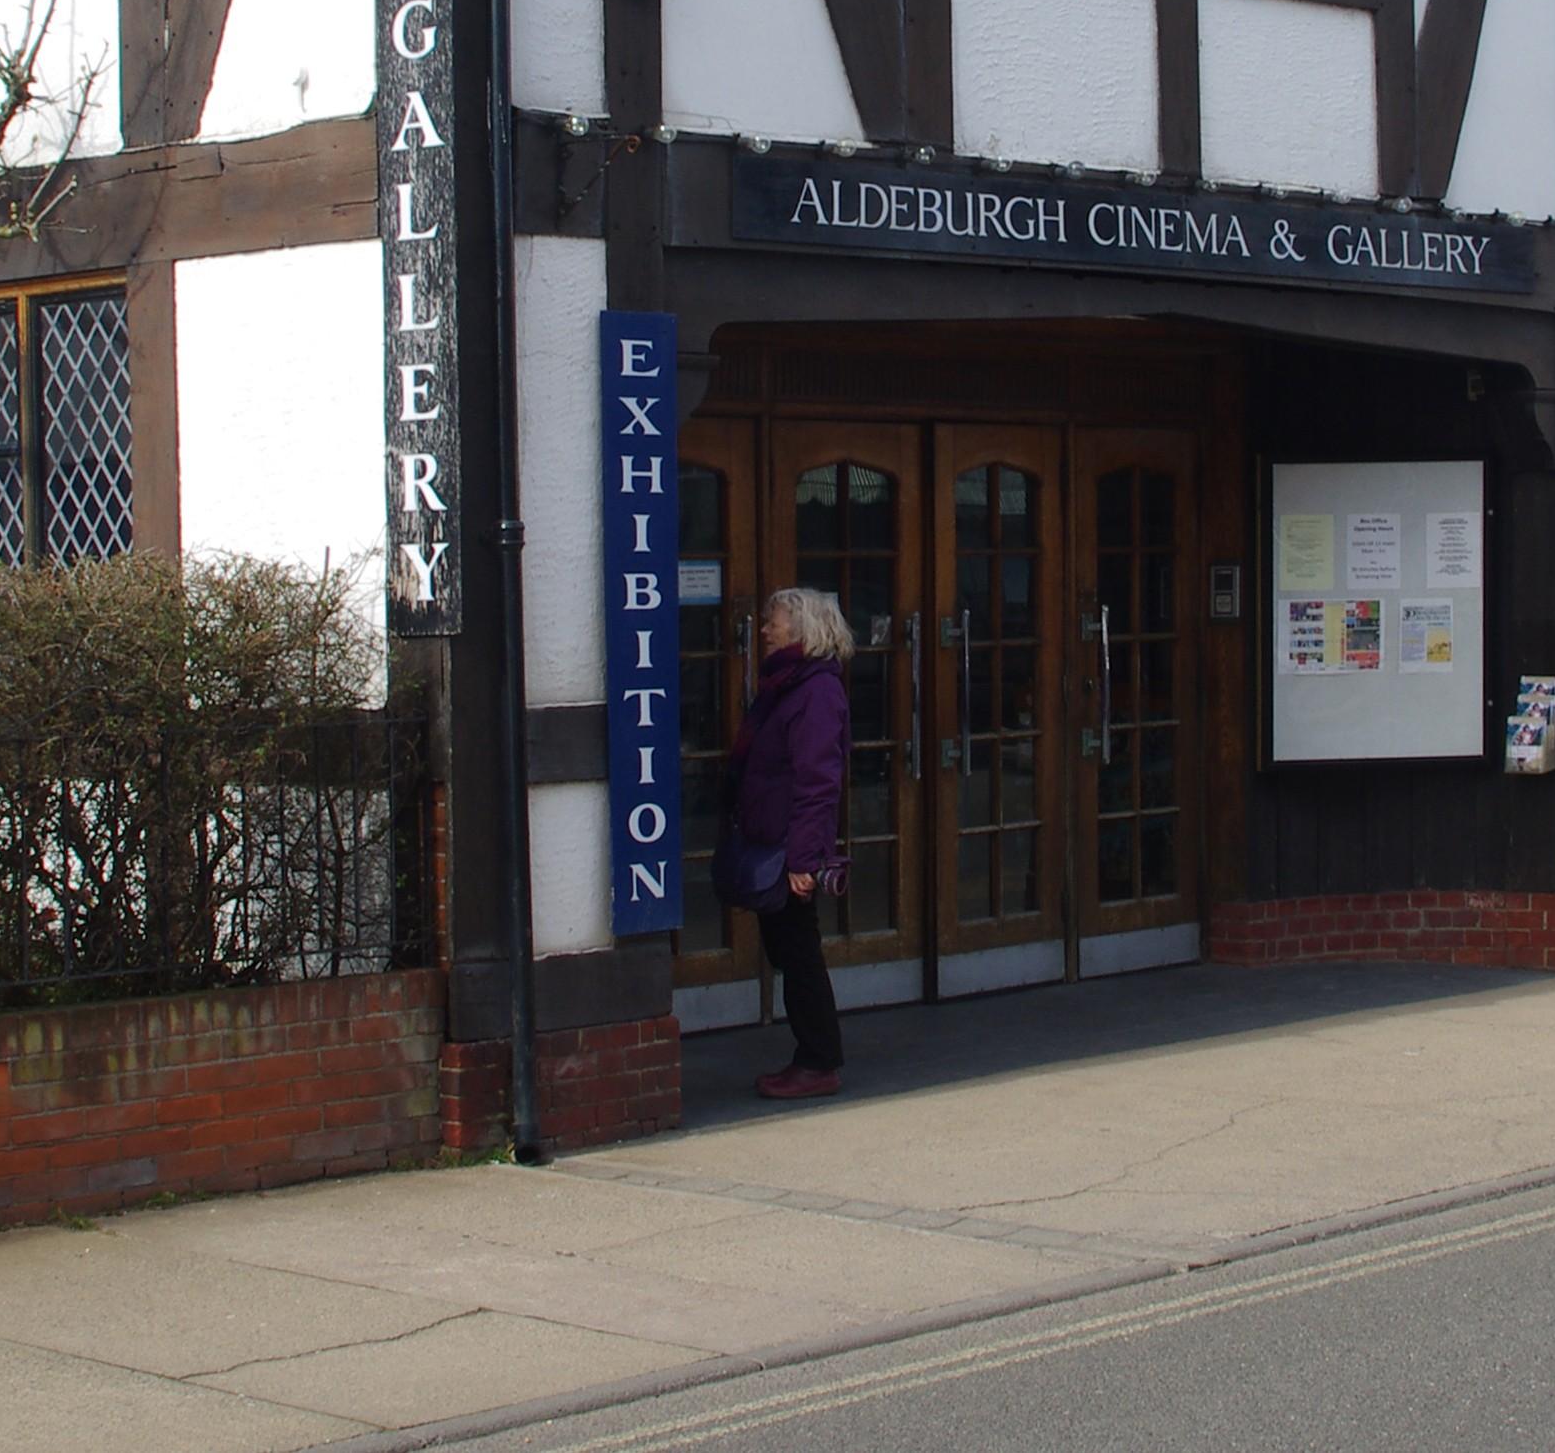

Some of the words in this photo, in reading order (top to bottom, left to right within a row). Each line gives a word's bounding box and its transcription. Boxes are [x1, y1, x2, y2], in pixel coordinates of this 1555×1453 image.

[790, 177, 1068, 242] ALDEBURGH
[1087, 202, 1251, 257] CINEMA
[1268, 219, 1306, 262] &
[1326, 225, 1491, 275] GALLERY
[619, 338, 668, 902] EXHIBITION
